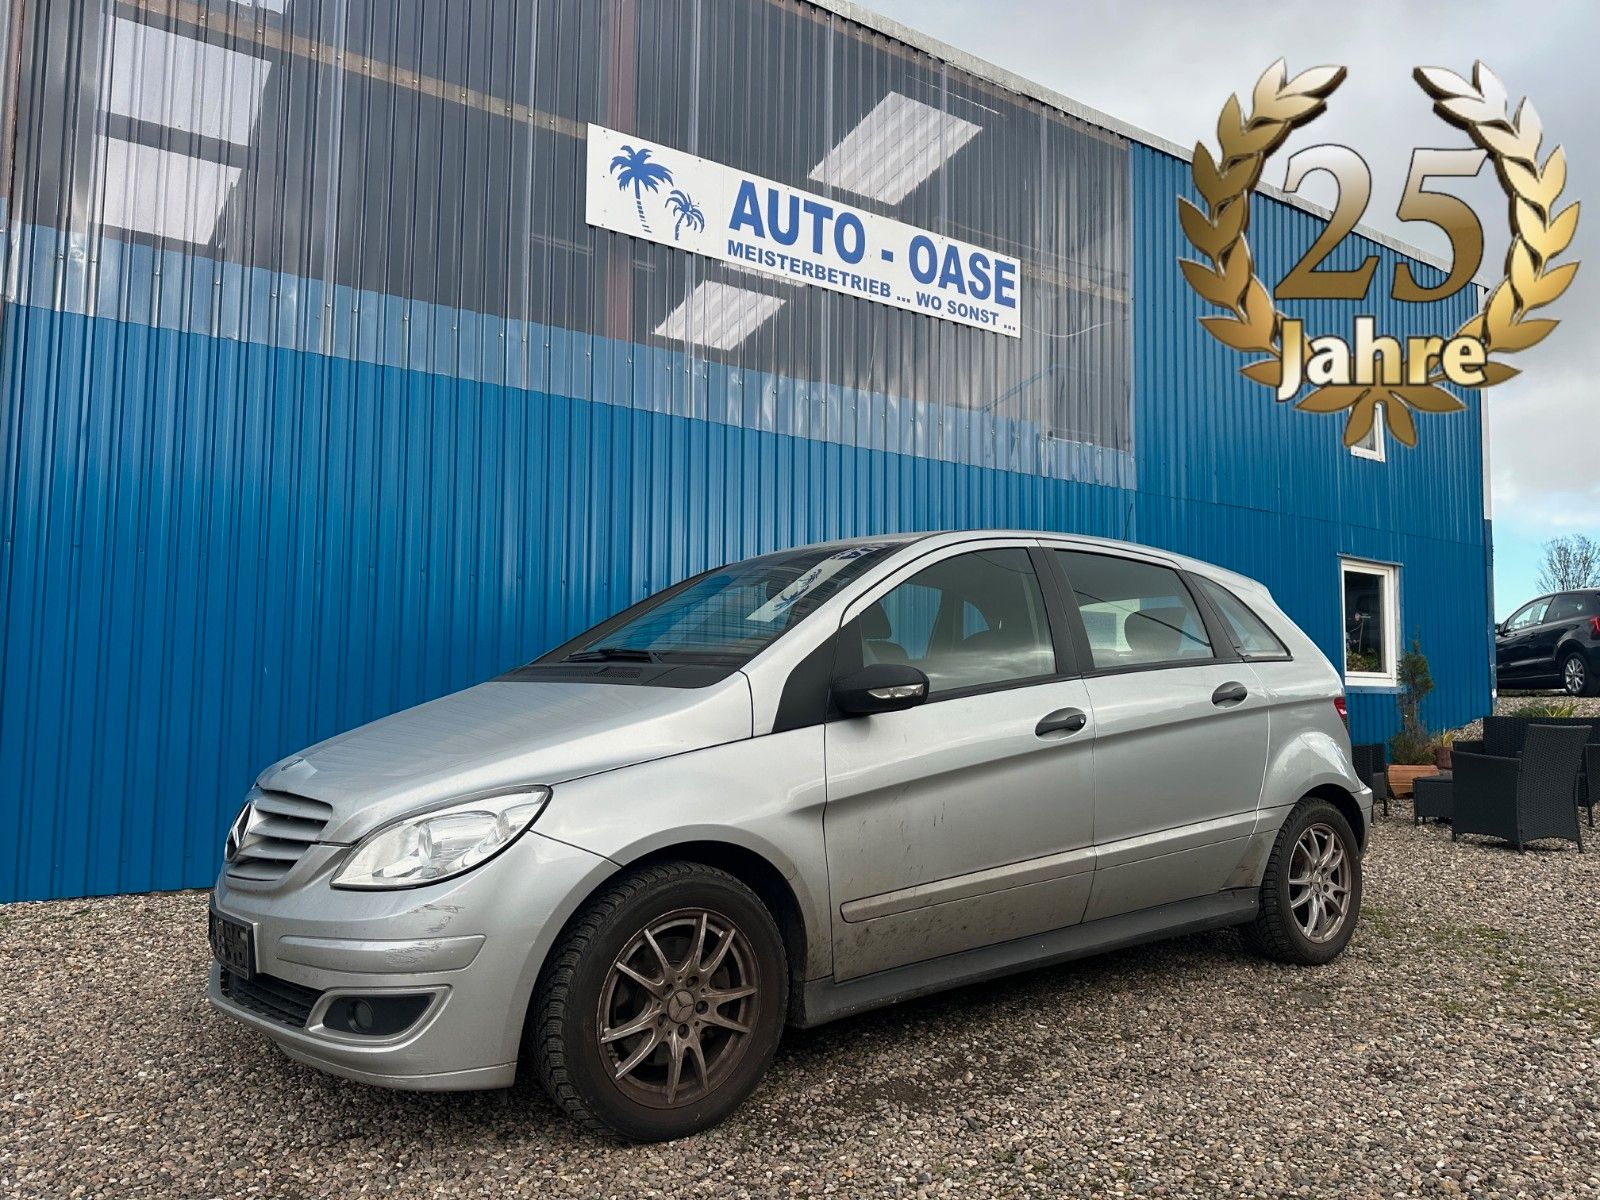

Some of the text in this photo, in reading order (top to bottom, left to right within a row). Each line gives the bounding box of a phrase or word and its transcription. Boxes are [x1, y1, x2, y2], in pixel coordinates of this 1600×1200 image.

[727, 239, 891, 298] MEISTERBETRIEB
[916, 291, 942, 311] WO
[947, 300, 999, 326] SONST
[729, 180, 866, 264] AUTO
[908, 235, 1016, 309] OASE
